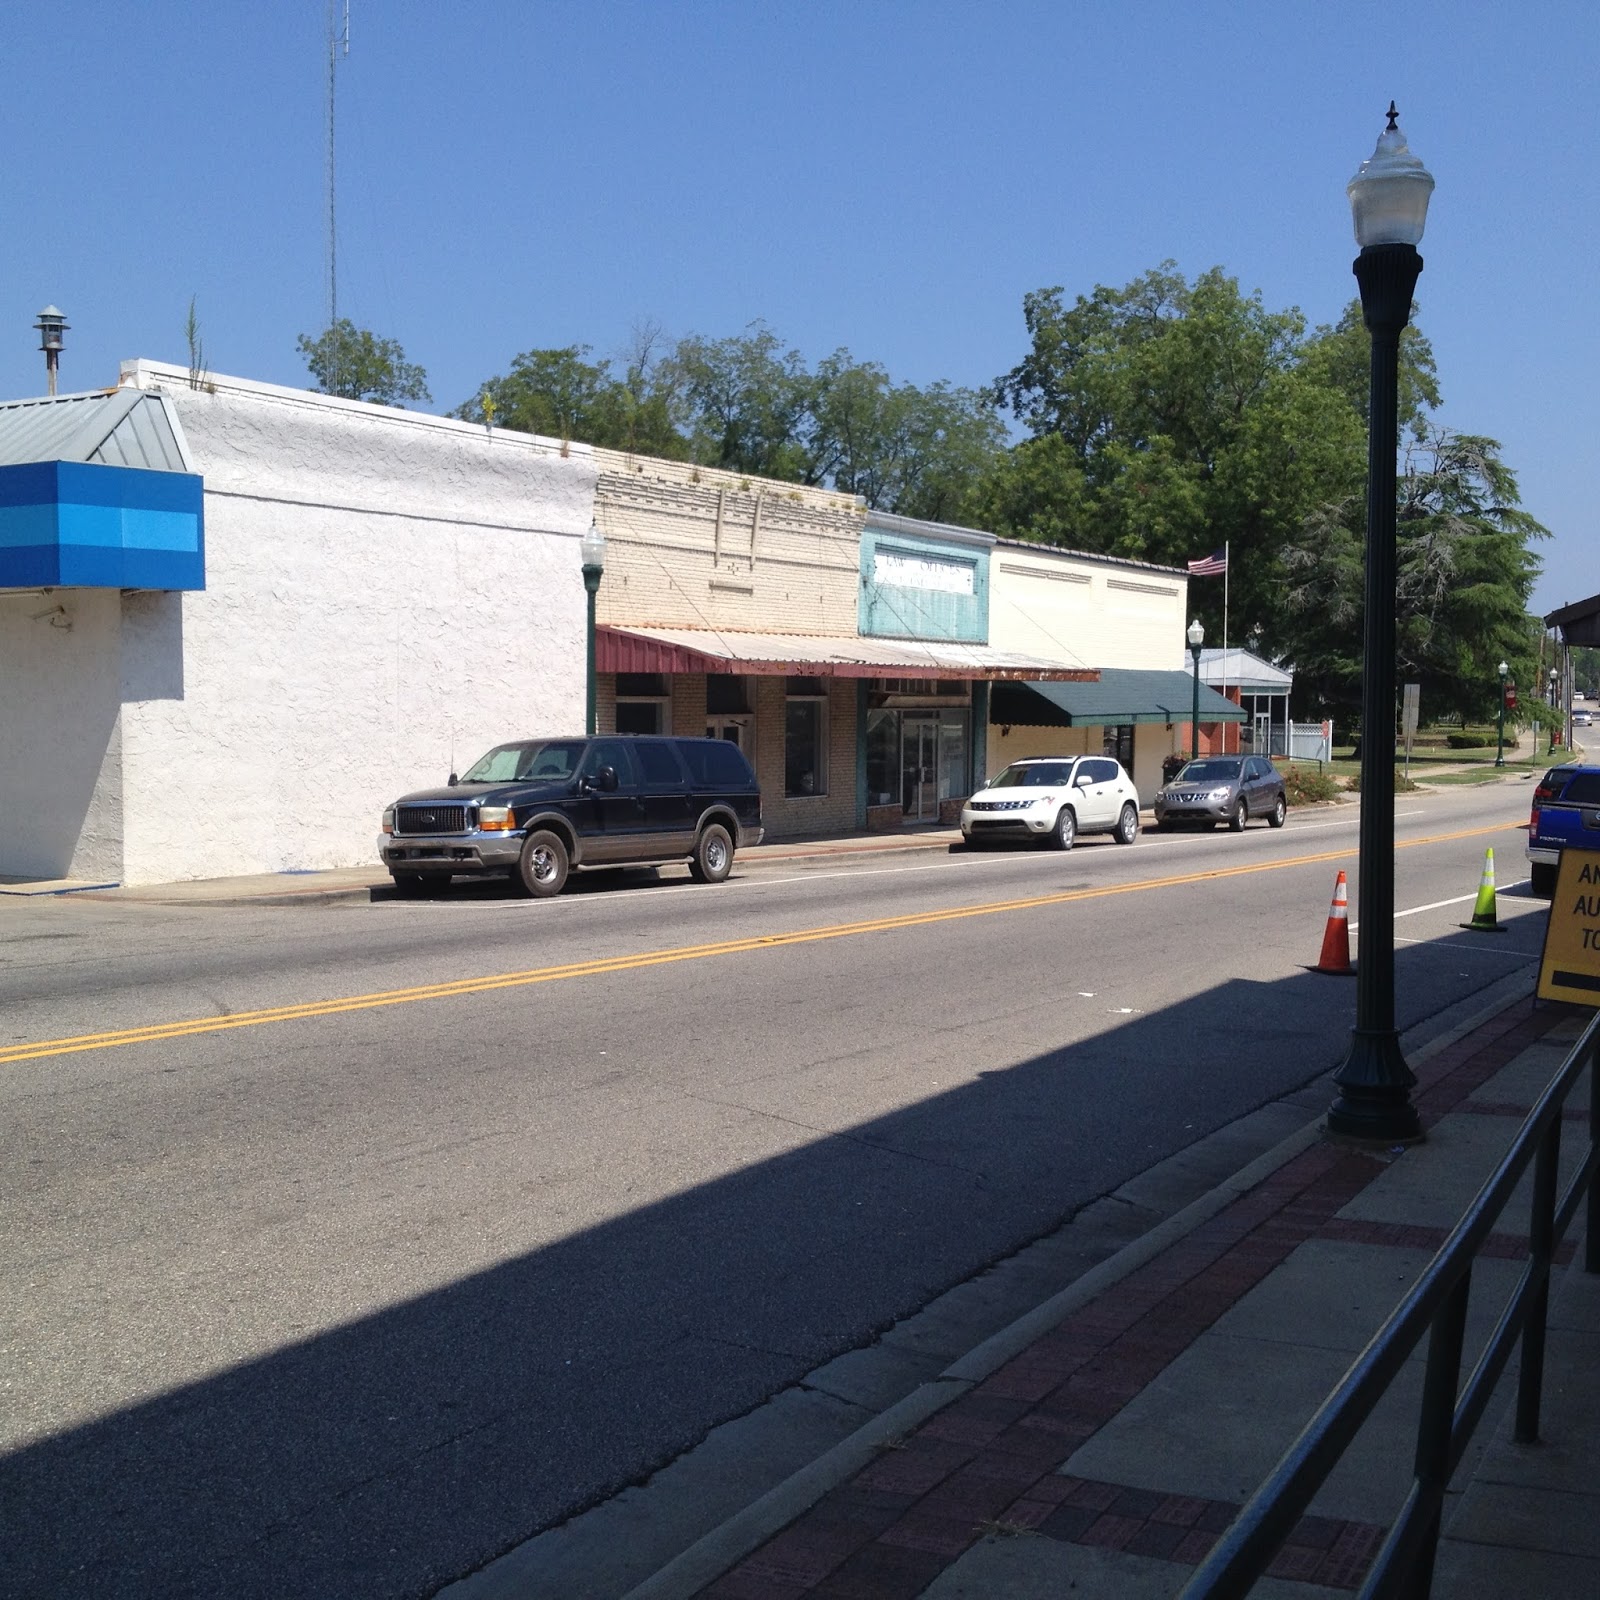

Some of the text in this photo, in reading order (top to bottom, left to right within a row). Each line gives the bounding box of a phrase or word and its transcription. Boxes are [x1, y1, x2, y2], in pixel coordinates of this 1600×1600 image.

[886, 556, 960, 575] LAW OFFICES
[1573, 895, 1600, 917] AU
